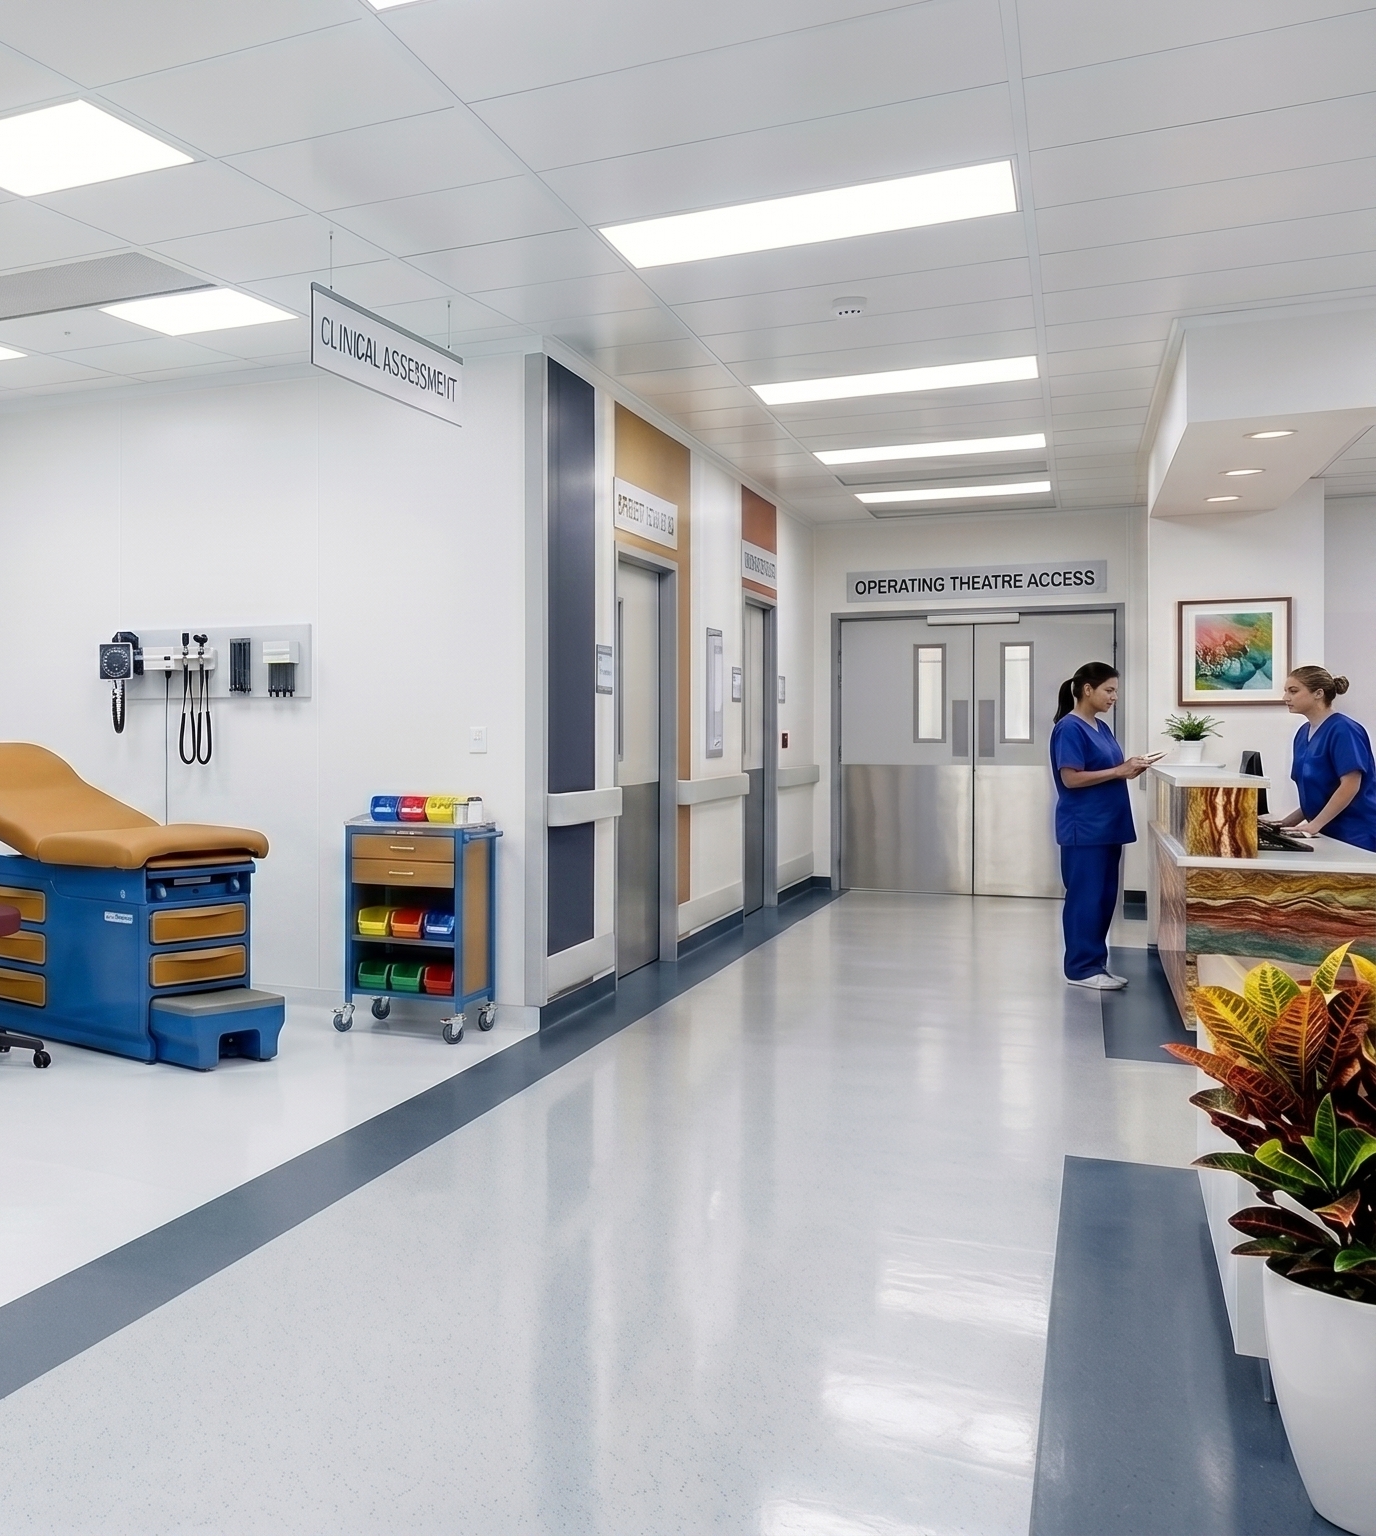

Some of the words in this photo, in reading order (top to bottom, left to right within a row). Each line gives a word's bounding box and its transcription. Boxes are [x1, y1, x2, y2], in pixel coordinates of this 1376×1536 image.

[321, 316, 380, 369] CLINICAL
[855, 577, 945, 595] OPERATING
[950, 573, 1024, 591] THEATRE
[1027, 570, 1095, 588] ACCESS
